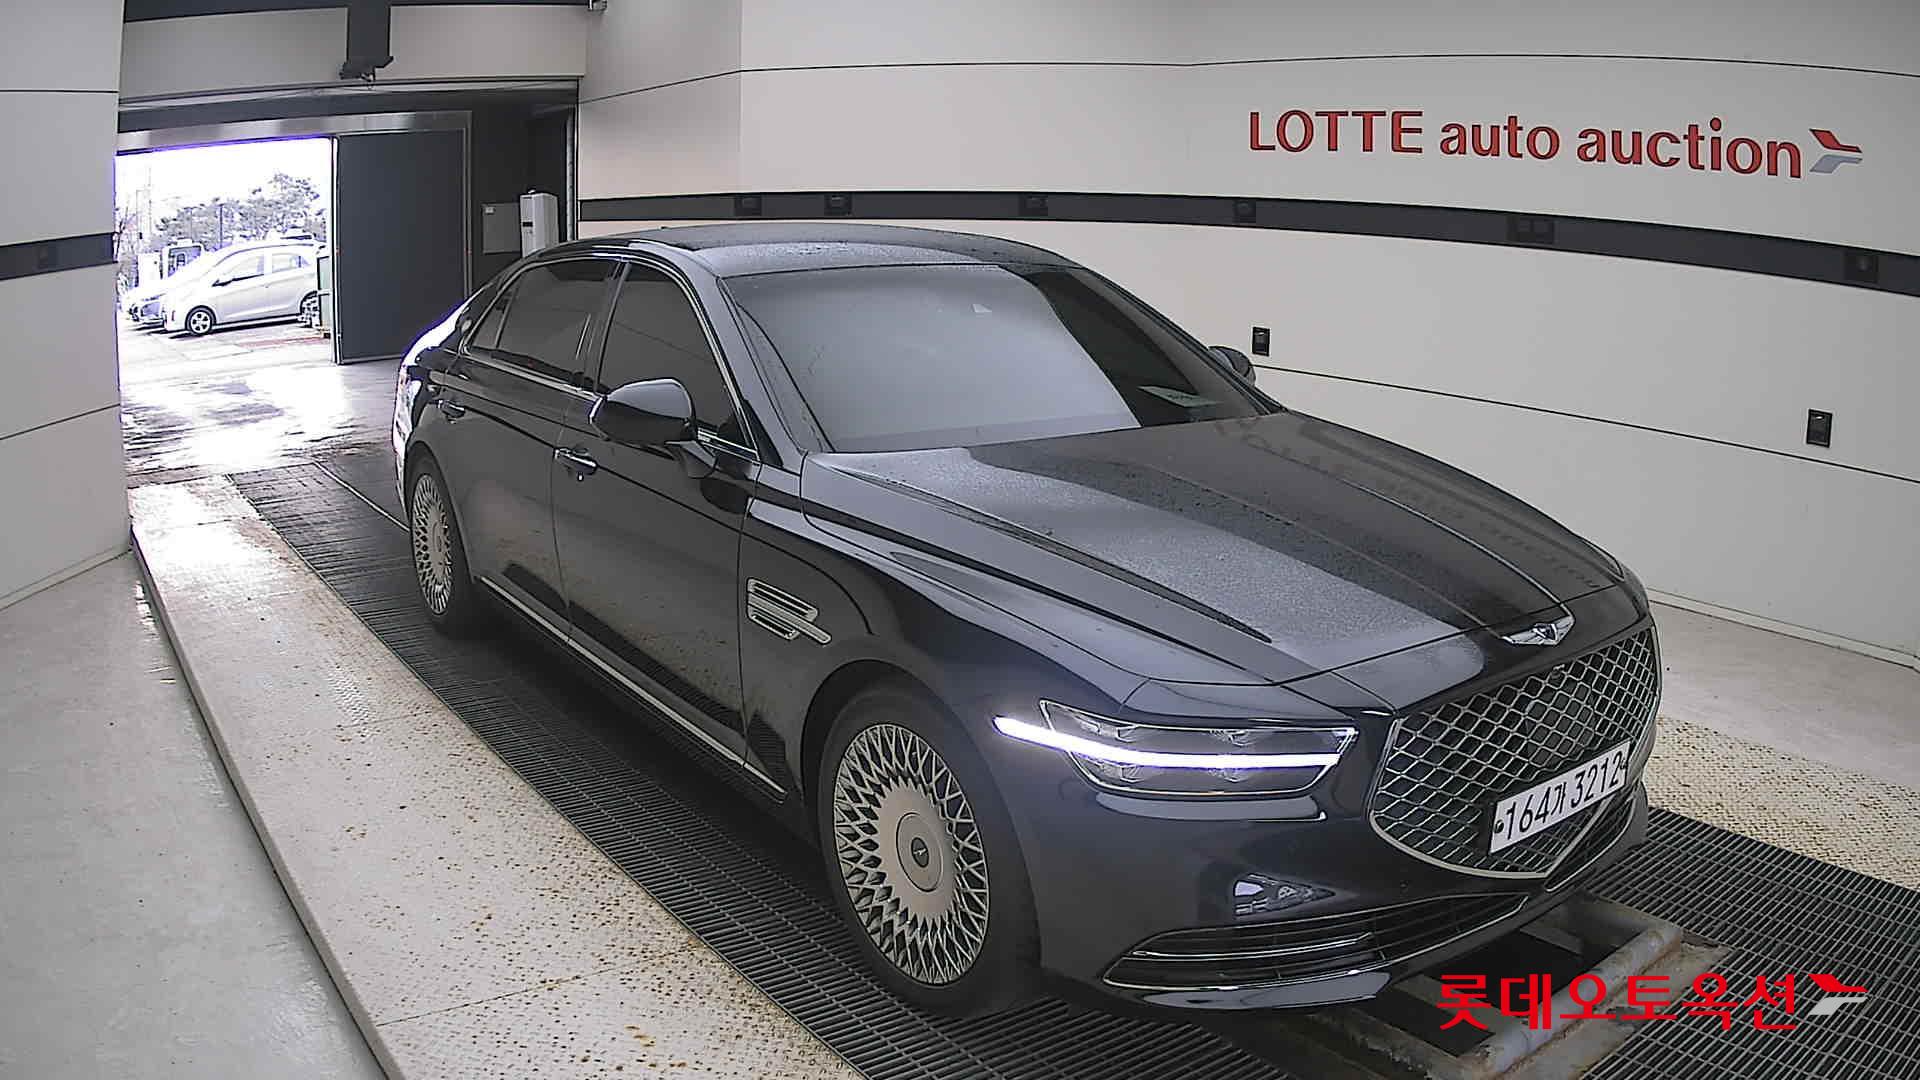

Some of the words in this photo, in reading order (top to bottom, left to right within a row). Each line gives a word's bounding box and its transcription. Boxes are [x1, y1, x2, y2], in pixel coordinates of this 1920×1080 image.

[1249, 110, 1423, 154] LOTTE
[1439, 115, 1560, 160] auto
[1576, 117, 1802, 179] auction
[1571, 750, 1623, 809] 3212
